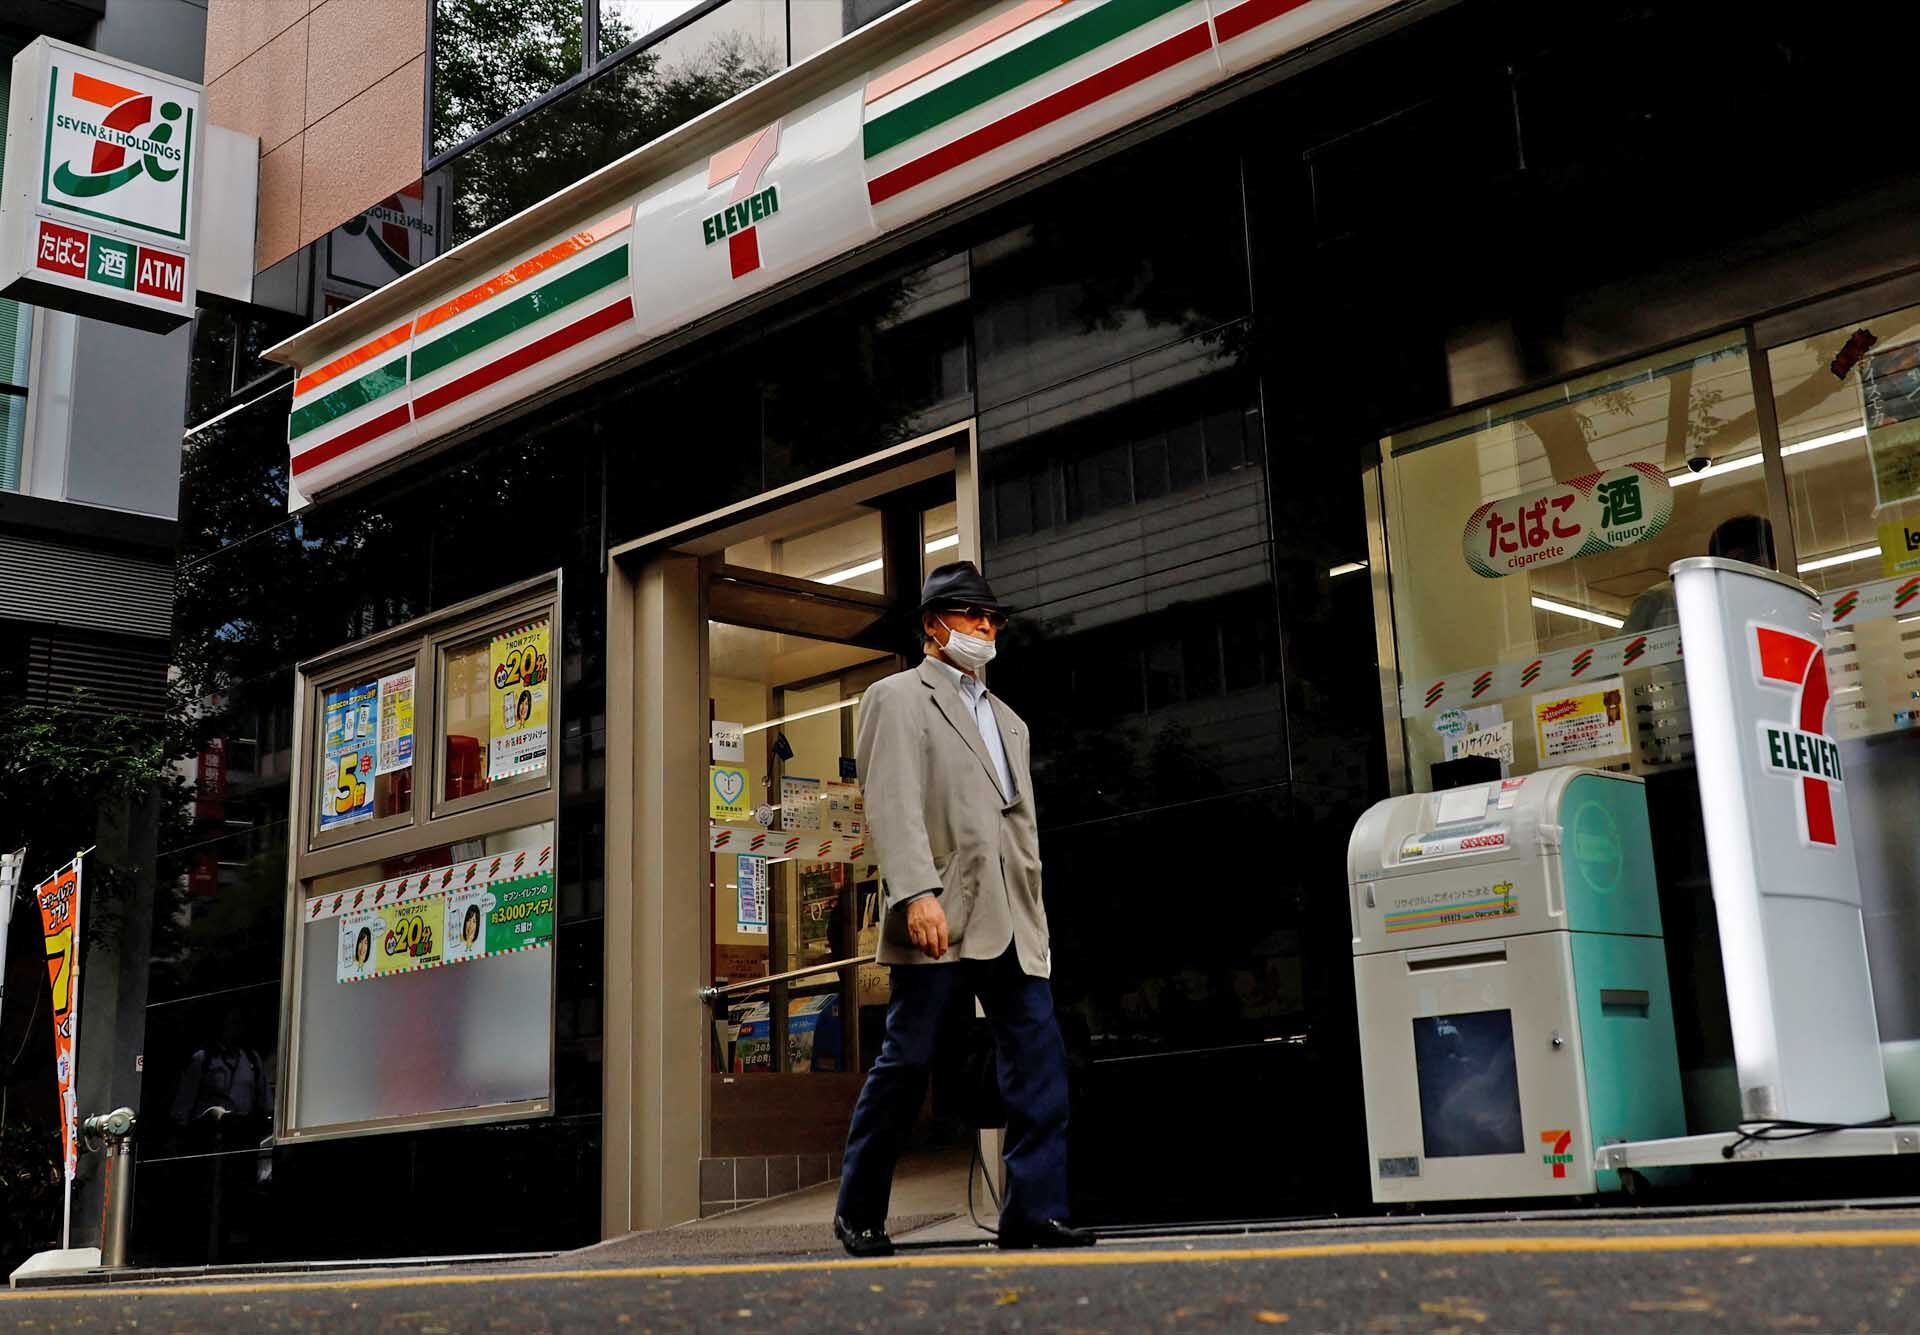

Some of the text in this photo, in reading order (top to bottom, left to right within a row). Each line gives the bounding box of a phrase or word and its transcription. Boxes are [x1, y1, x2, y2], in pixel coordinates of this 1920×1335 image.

[116, 131, 182, 162] HOLDINGS
[40, 232, 86, 269] たばこ
[97, 246, 129, 281] 酒
[139, 260, 182, 293] ATM
[1597, 475, 1643, 528] 酒
[1487, 494, 1581, 558] たばこ
[1607, 523, 1647, 544] liquor
[1508, 545, 1564, 569] cigarette
[1461, 731, 1502, 753] リサイクル
[1756, 626, 1838, 846] 7
[1540, 1129, 1573, 1179] 7
